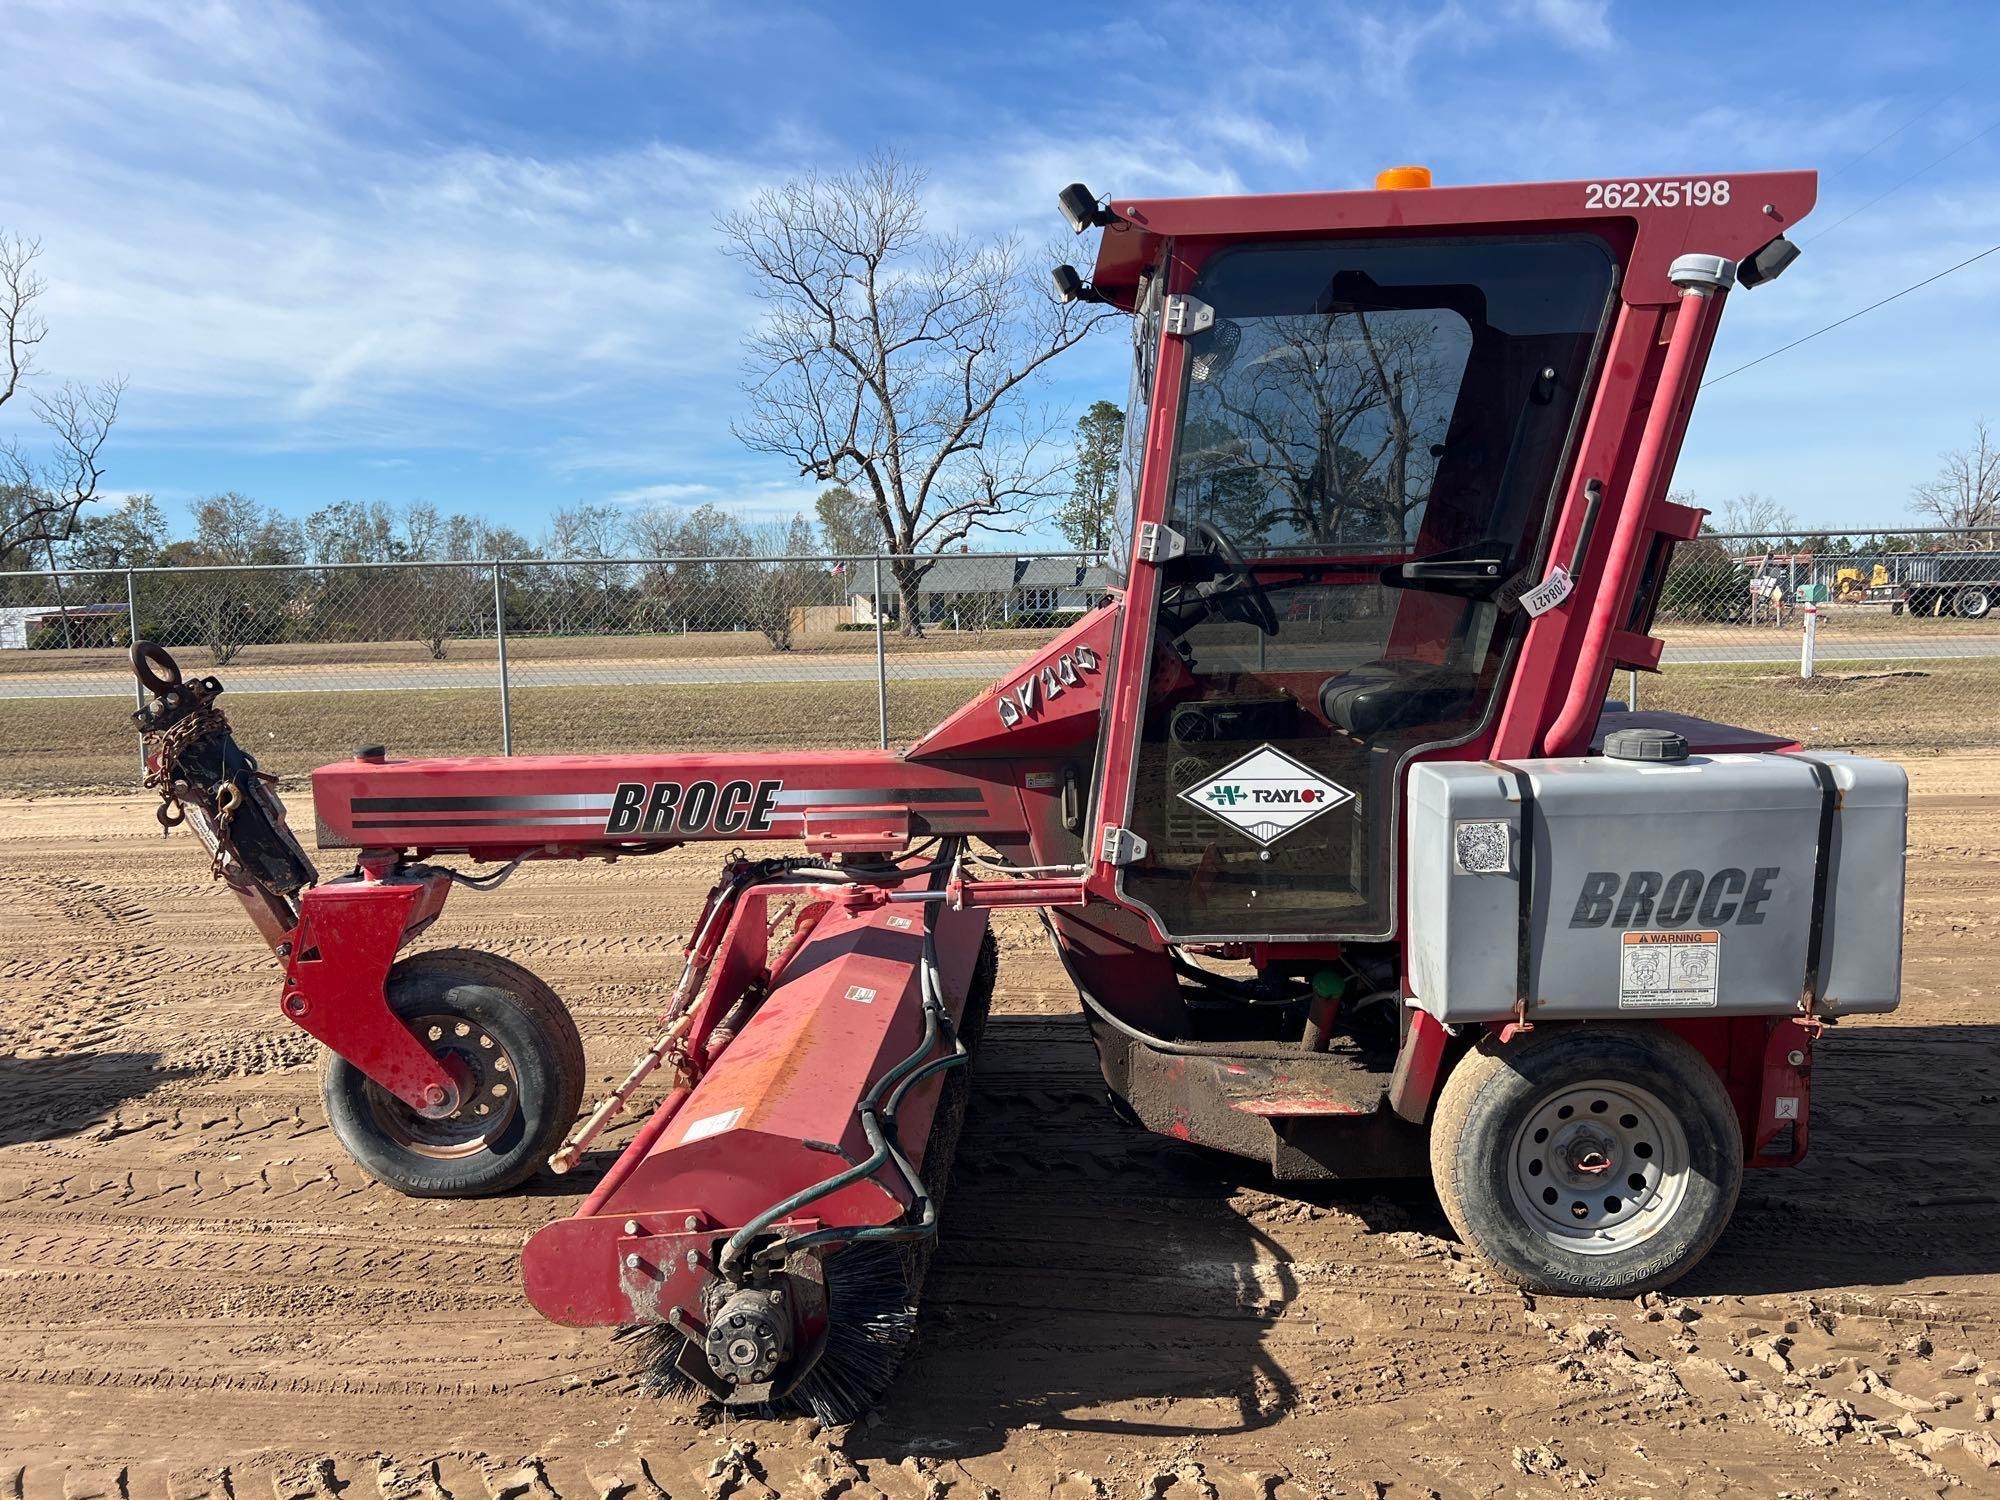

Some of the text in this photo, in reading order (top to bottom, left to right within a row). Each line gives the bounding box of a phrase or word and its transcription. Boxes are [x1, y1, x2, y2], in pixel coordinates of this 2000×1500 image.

[1584, 180, 1731, 209] 262X5198
[1532, 579, 1566, 611] 208427
[604, 779, 783, 835] BROCE
[1252, 788, 1325, 804] TRAYLOR
[1568, 866, 1781, 930] BROCE
[1650, 933, 1702, 943] WARNING
